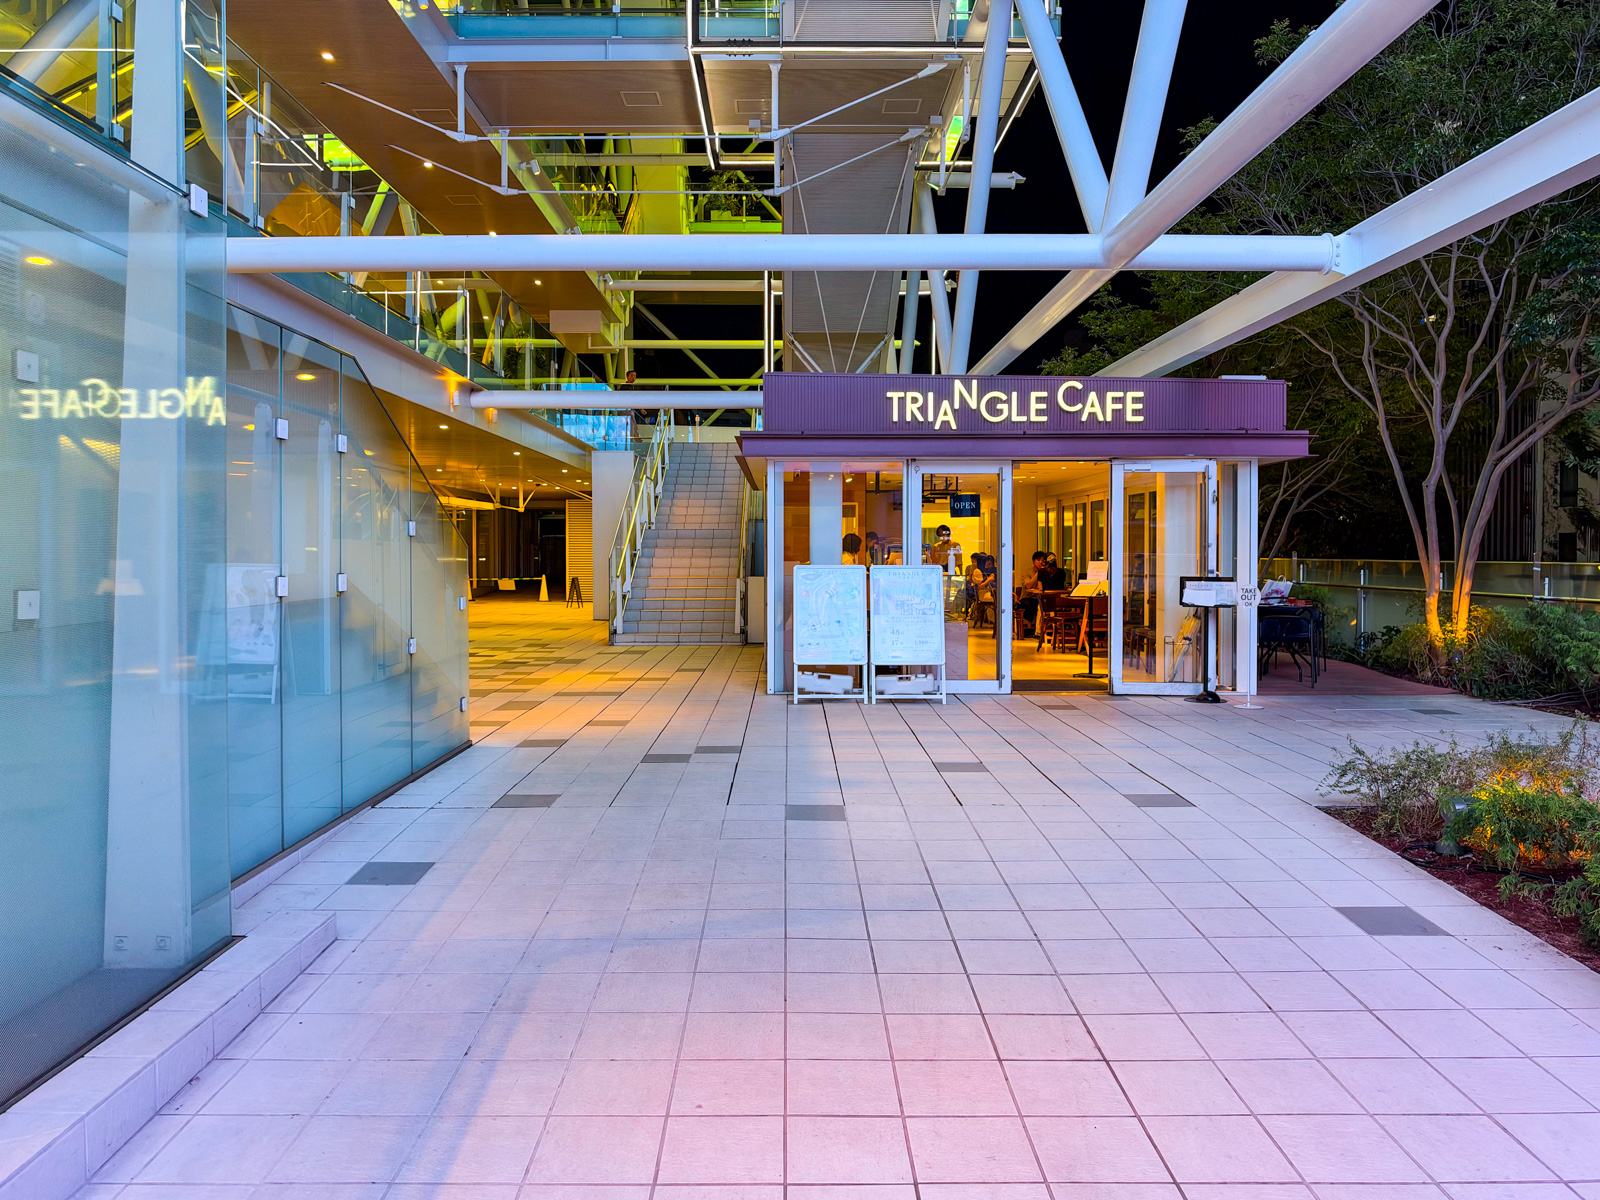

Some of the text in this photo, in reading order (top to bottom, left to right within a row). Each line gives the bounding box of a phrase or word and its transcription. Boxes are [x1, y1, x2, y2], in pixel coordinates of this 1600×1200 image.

[886, 379, 1144, 430] TRIANGLE CAFE
[954, 501, 976, 510] OPEN
